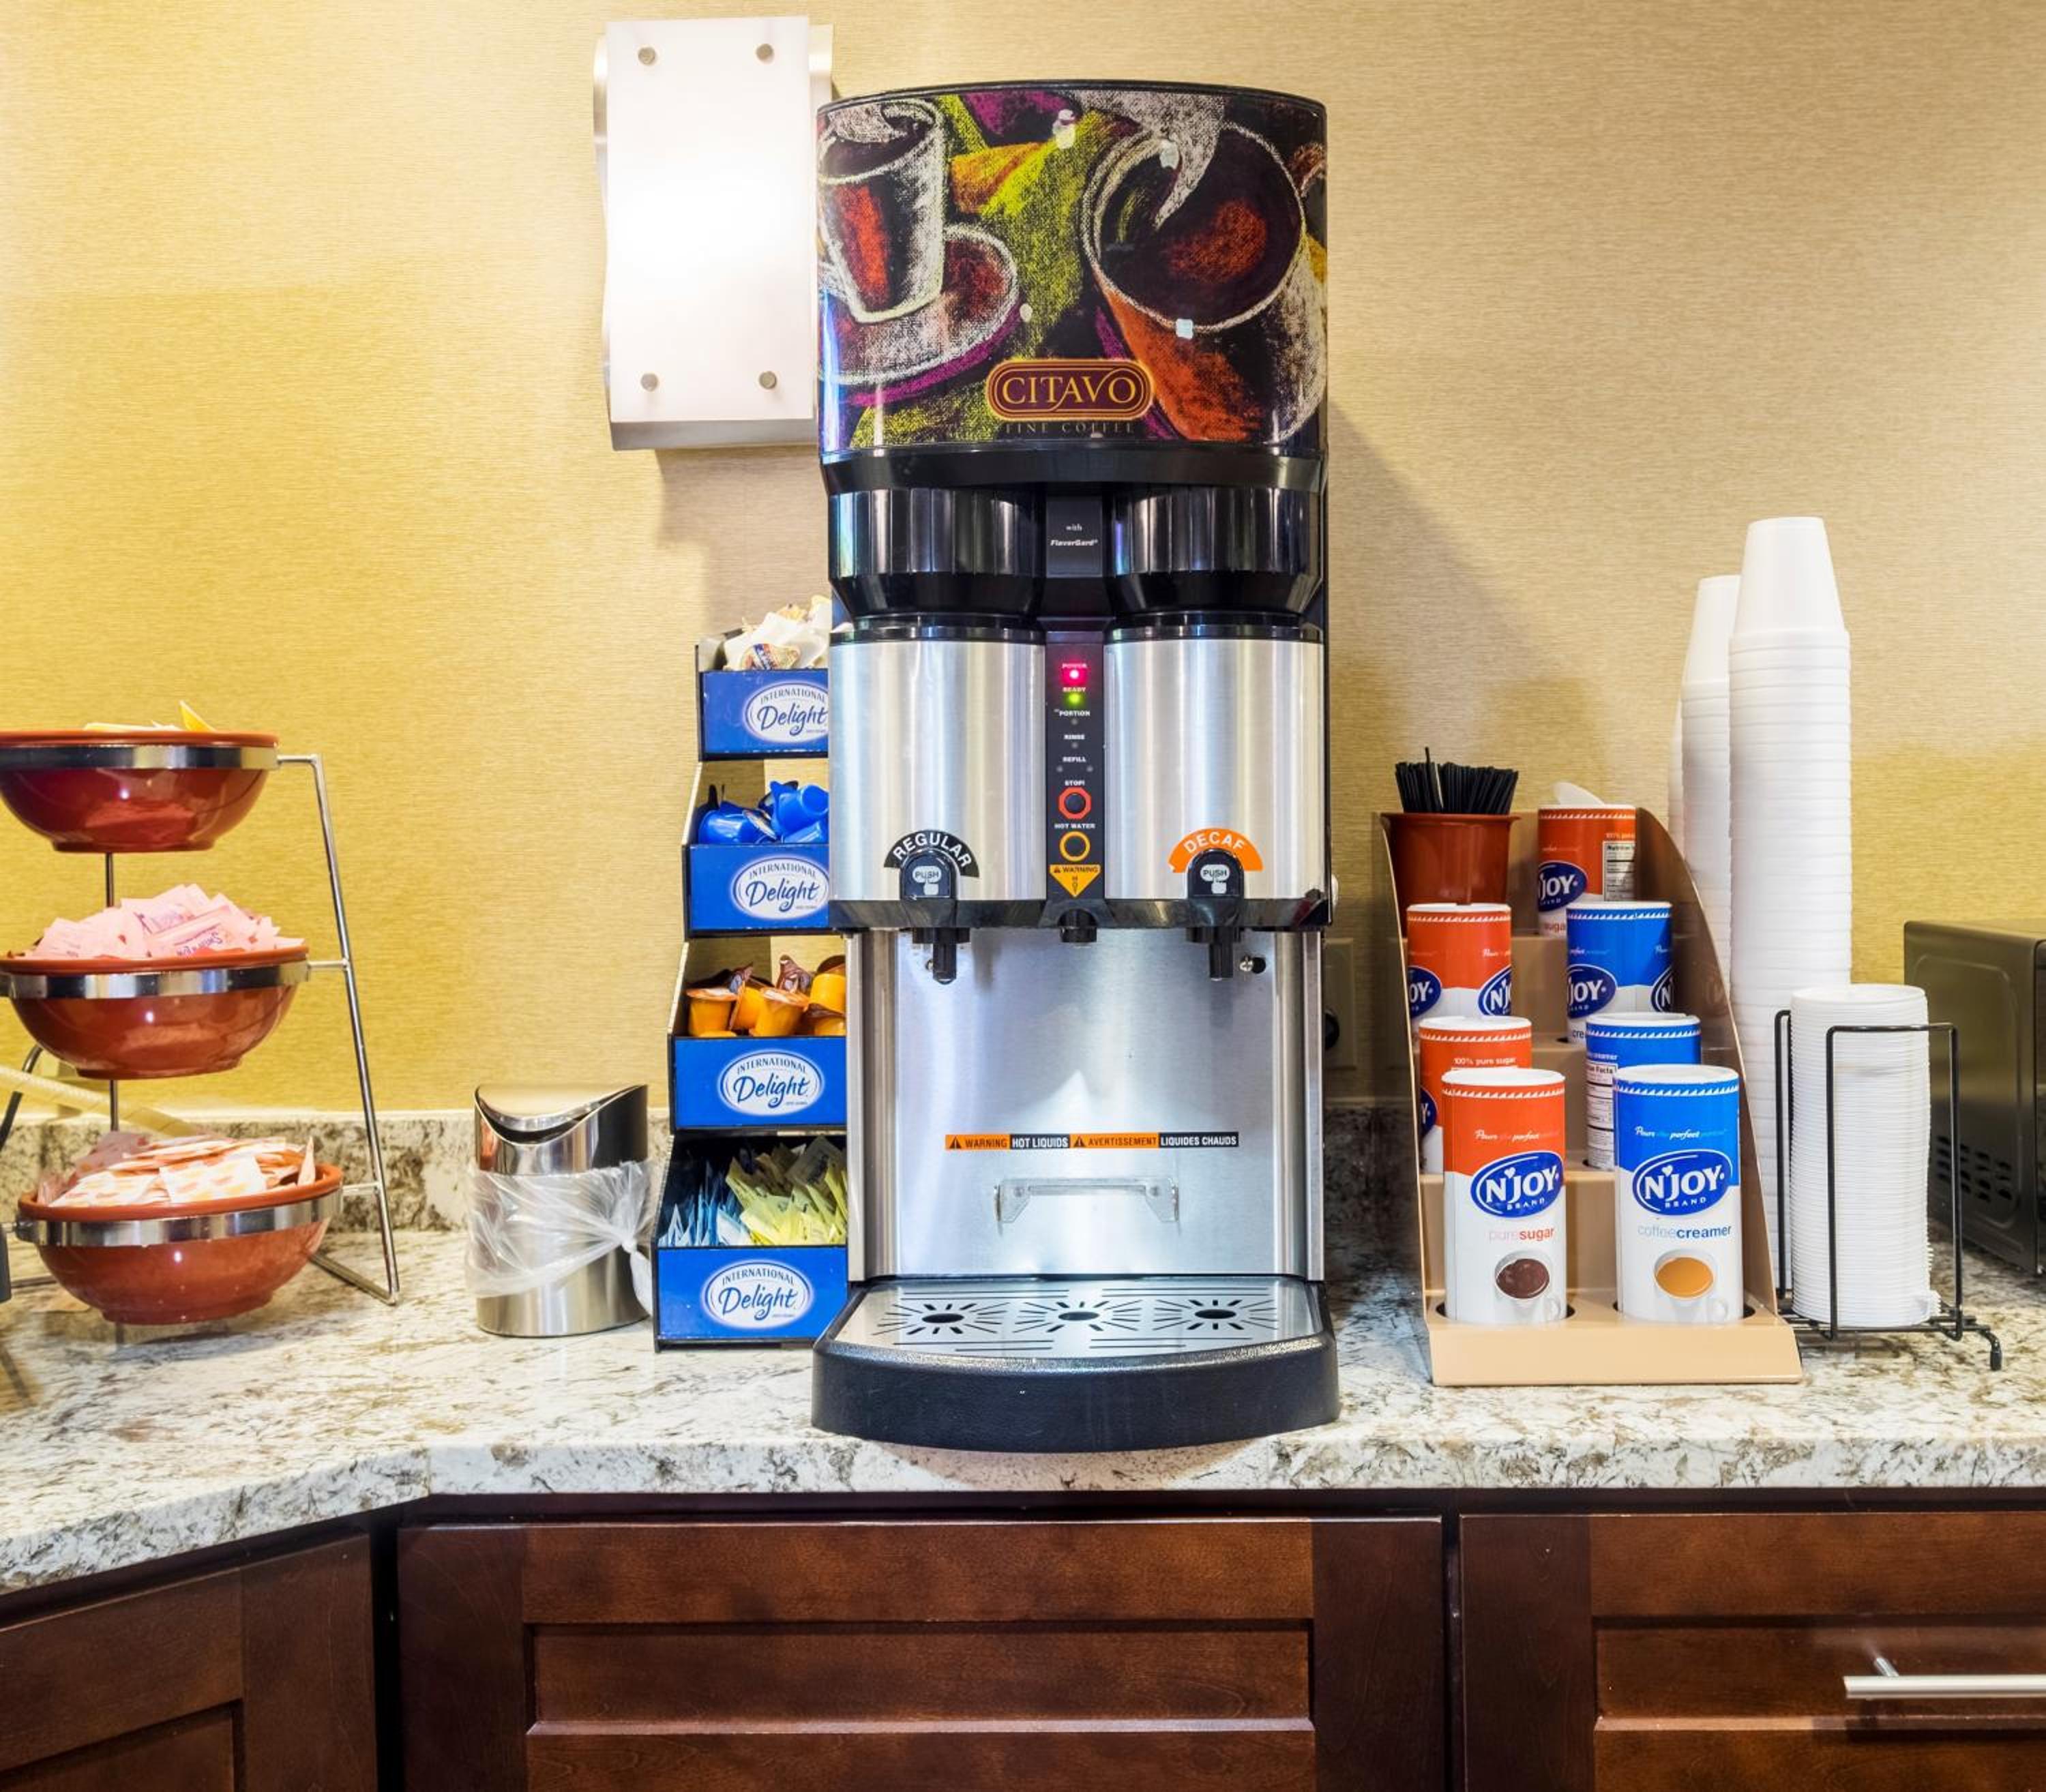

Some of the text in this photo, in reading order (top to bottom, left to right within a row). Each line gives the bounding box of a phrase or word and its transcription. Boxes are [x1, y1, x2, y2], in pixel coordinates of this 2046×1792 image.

[1002, 376, 1136, 404] CITAVO
[760, 687, 825, 704] INTERNATIONAL
[756, 703, 828, 736] Delight
[893, 832, 972, 867] REGULAR
[1184, 831, 1245, 852] DECAF
[749, 862, 816, 880] INTERNATIONAL
[915, 870, 939, 878] PUSH
[1203, 869, 1228, 878] PUSH
[745, 878, 820, 912] Delight
[736, 1058, 806, 1075] INTERNATIONAL
[733, 1073, 810, 1108] Delight
[965, 1137, 1069, 1148] WARNING HOT LIQUIDS
[1088, 1135, 1237, 1146] AVERTISSEMENT LIQUIDES CHAUDS
[1670, 1129, 1700, 1140] perfect
[1507, 1198, 1545, 1211] BRAND
[1665, 1197, 1706, 1208] BRAND
[722, 1268, 795, 1286] INTERNATIONAL
[717, 1283, 797, 1321] Delight
